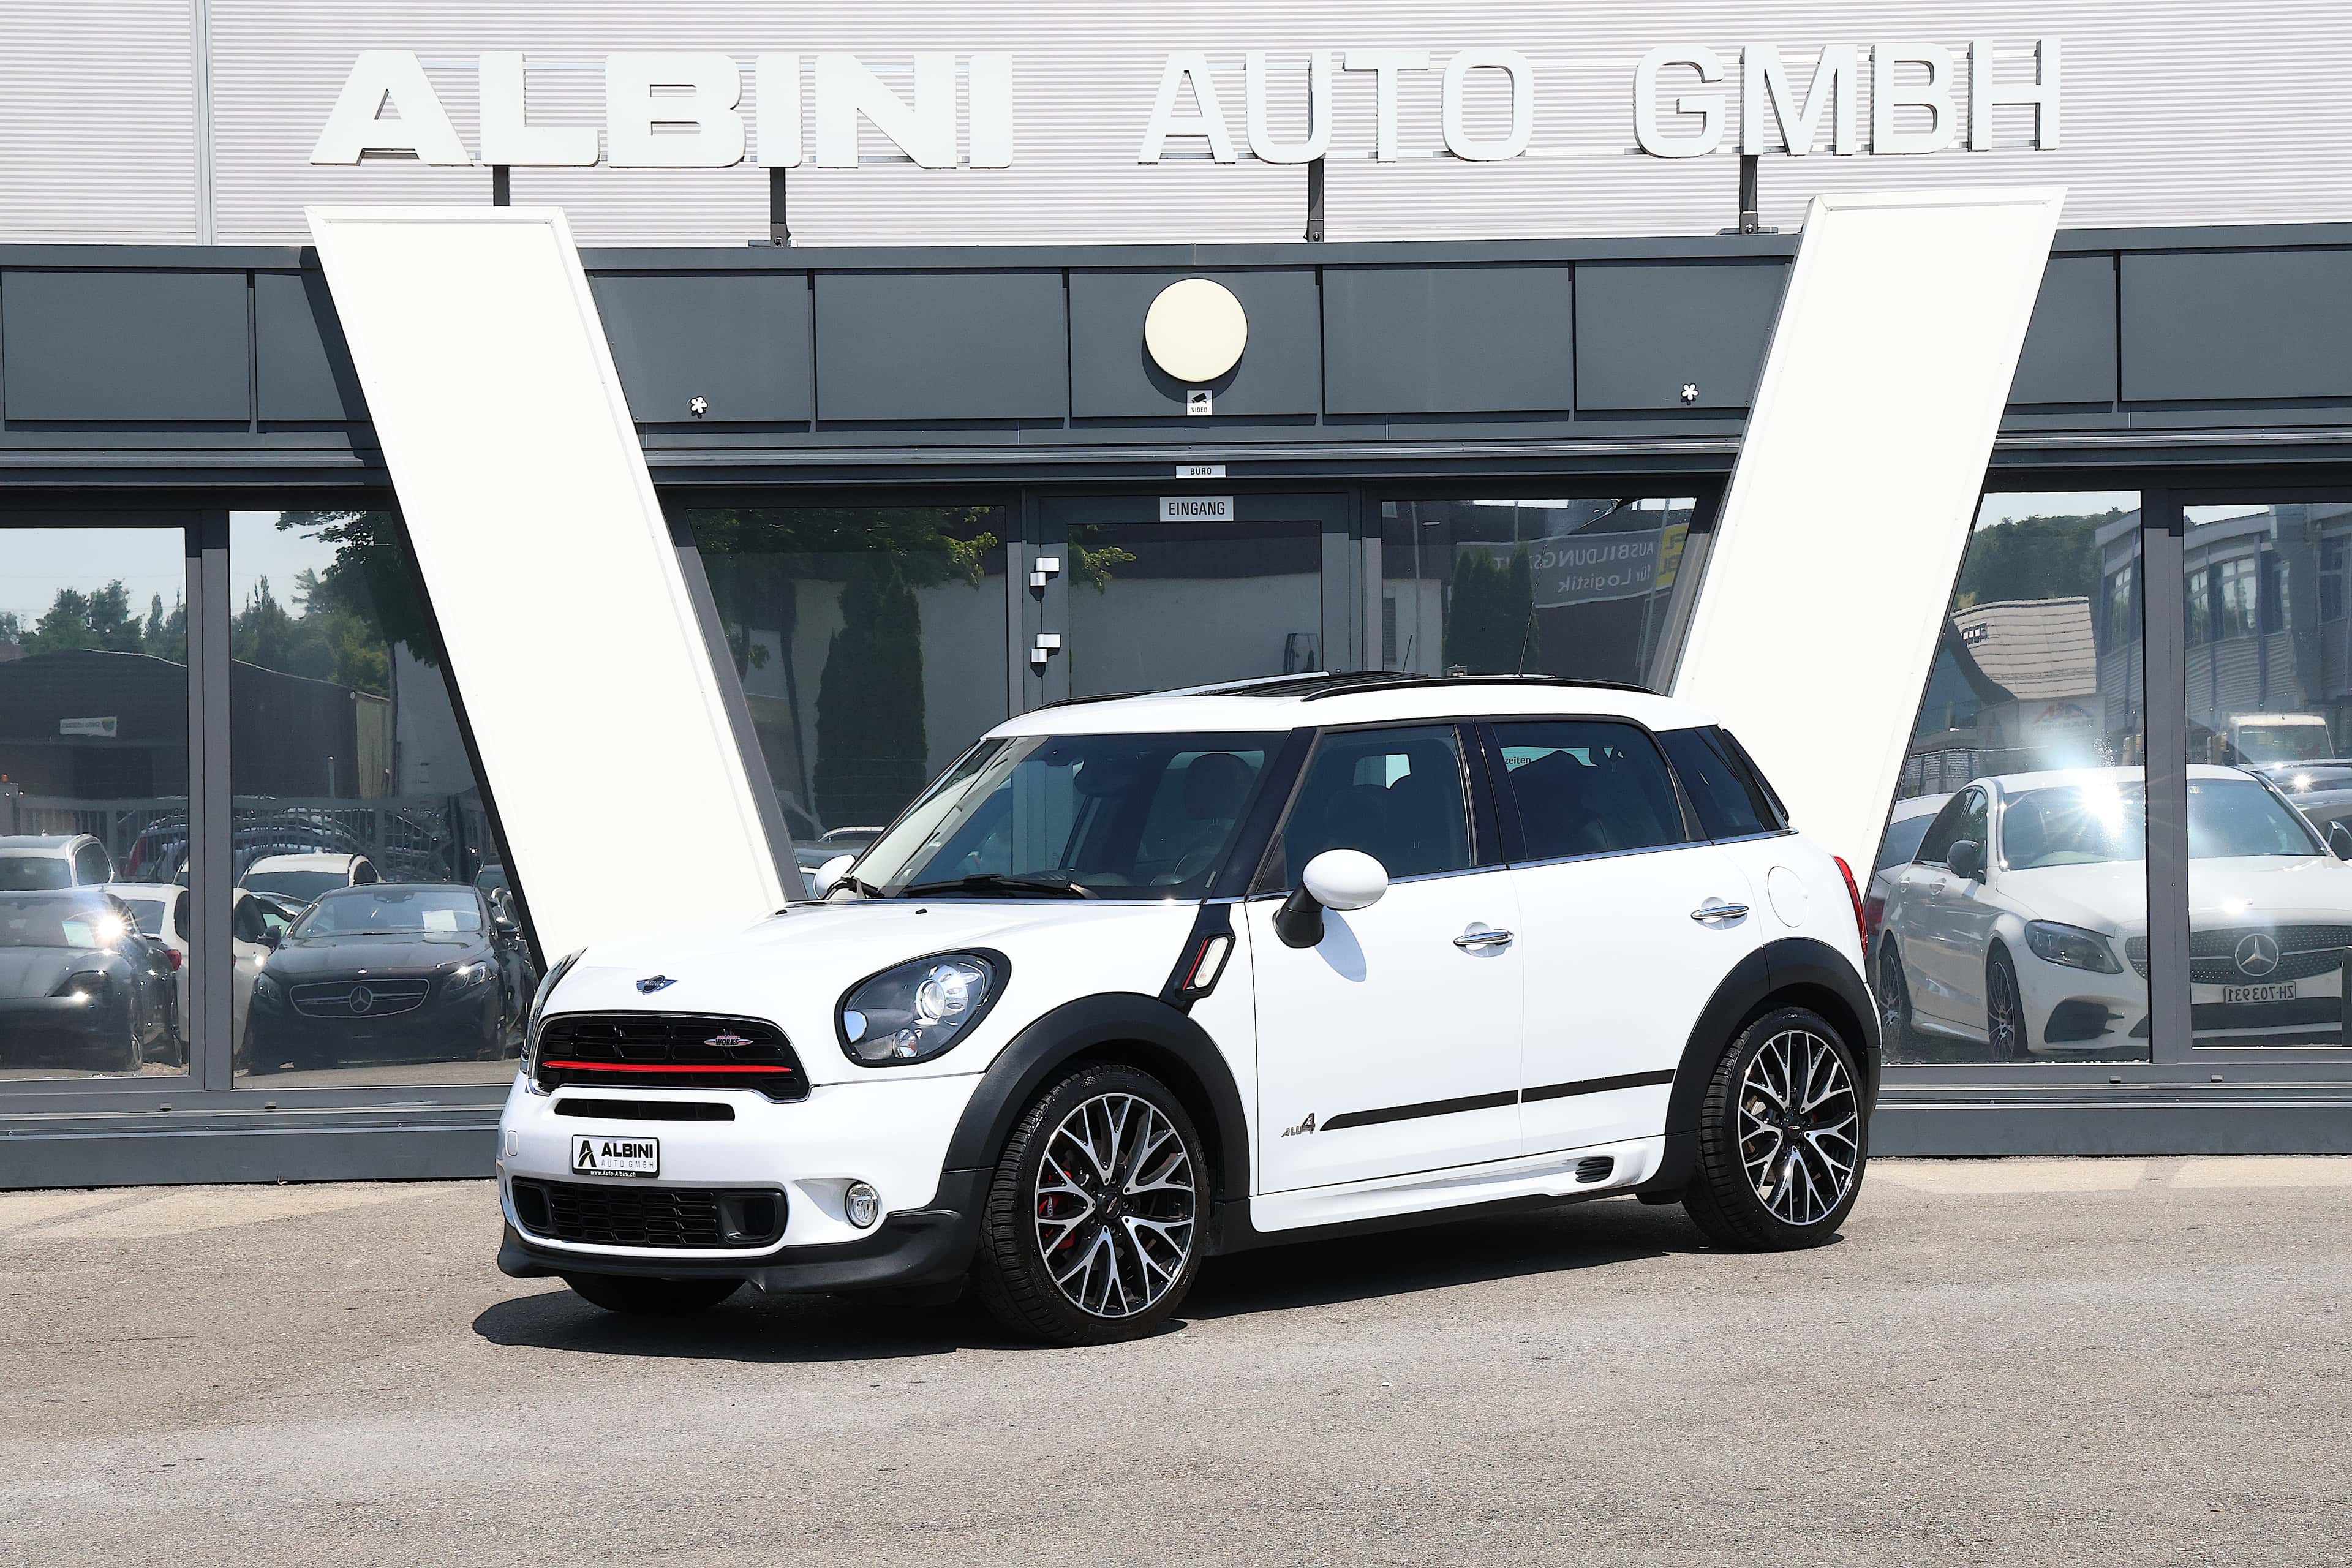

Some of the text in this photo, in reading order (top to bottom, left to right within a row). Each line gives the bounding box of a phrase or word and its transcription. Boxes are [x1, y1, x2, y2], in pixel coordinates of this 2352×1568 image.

[309, 35, 2063, 169] ALBINI AUTO GMBH
[1190, 467, 1212, 475] BÜRO
[1169, 502, 1226, 516] EINGANG
[601, 1142, 654, 1158] ALBINI
